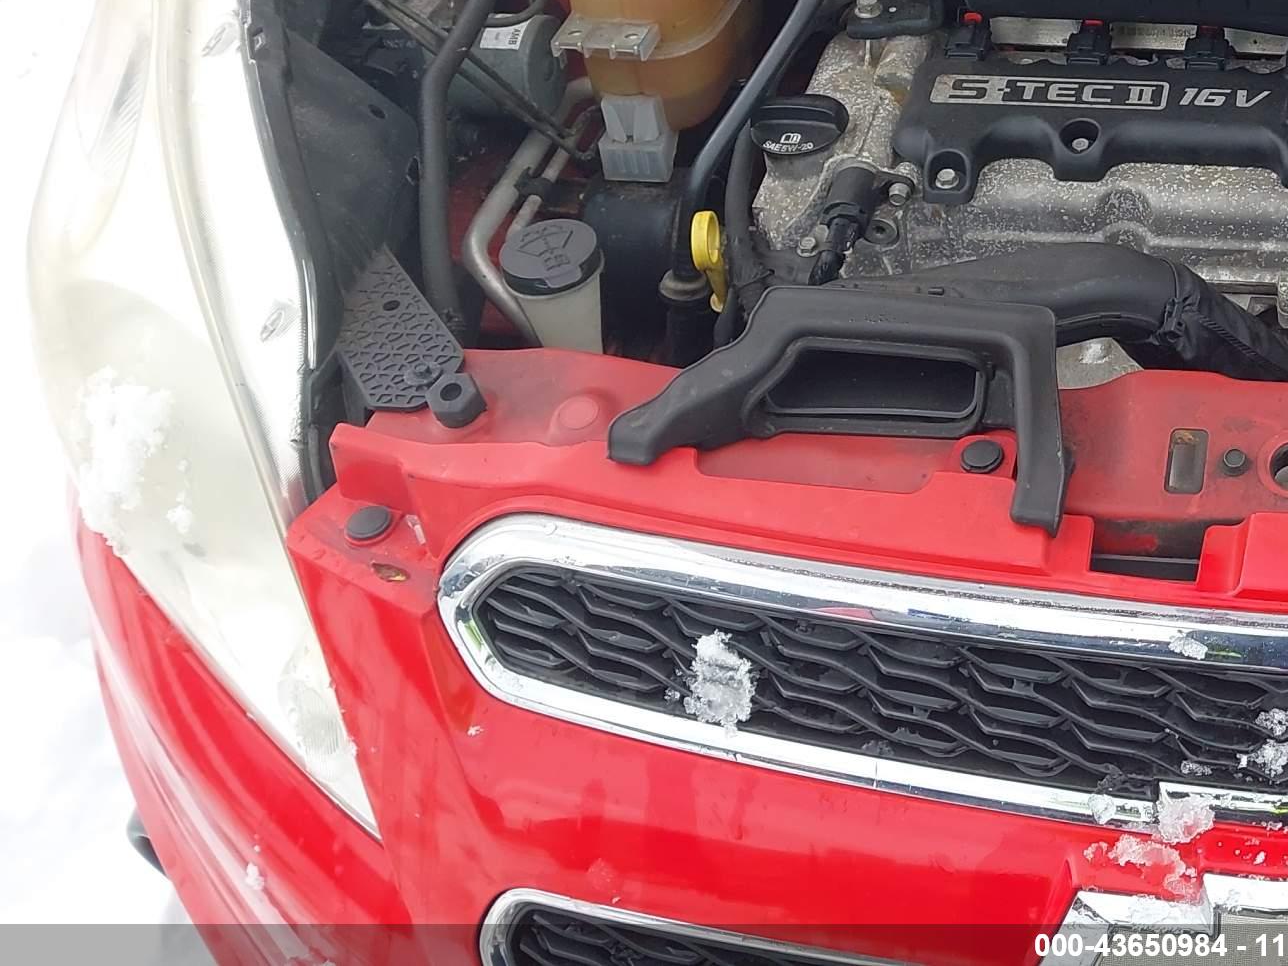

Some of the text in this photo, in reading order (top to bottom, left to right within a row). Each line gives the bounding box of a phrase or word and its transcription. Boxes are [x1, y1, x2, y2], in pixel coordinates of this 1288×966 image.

[1125, 86, 1157, 105] II
[1178, 87, 1272, 108] 16V
[763, 140, 814, 152] SAE 5W-20
